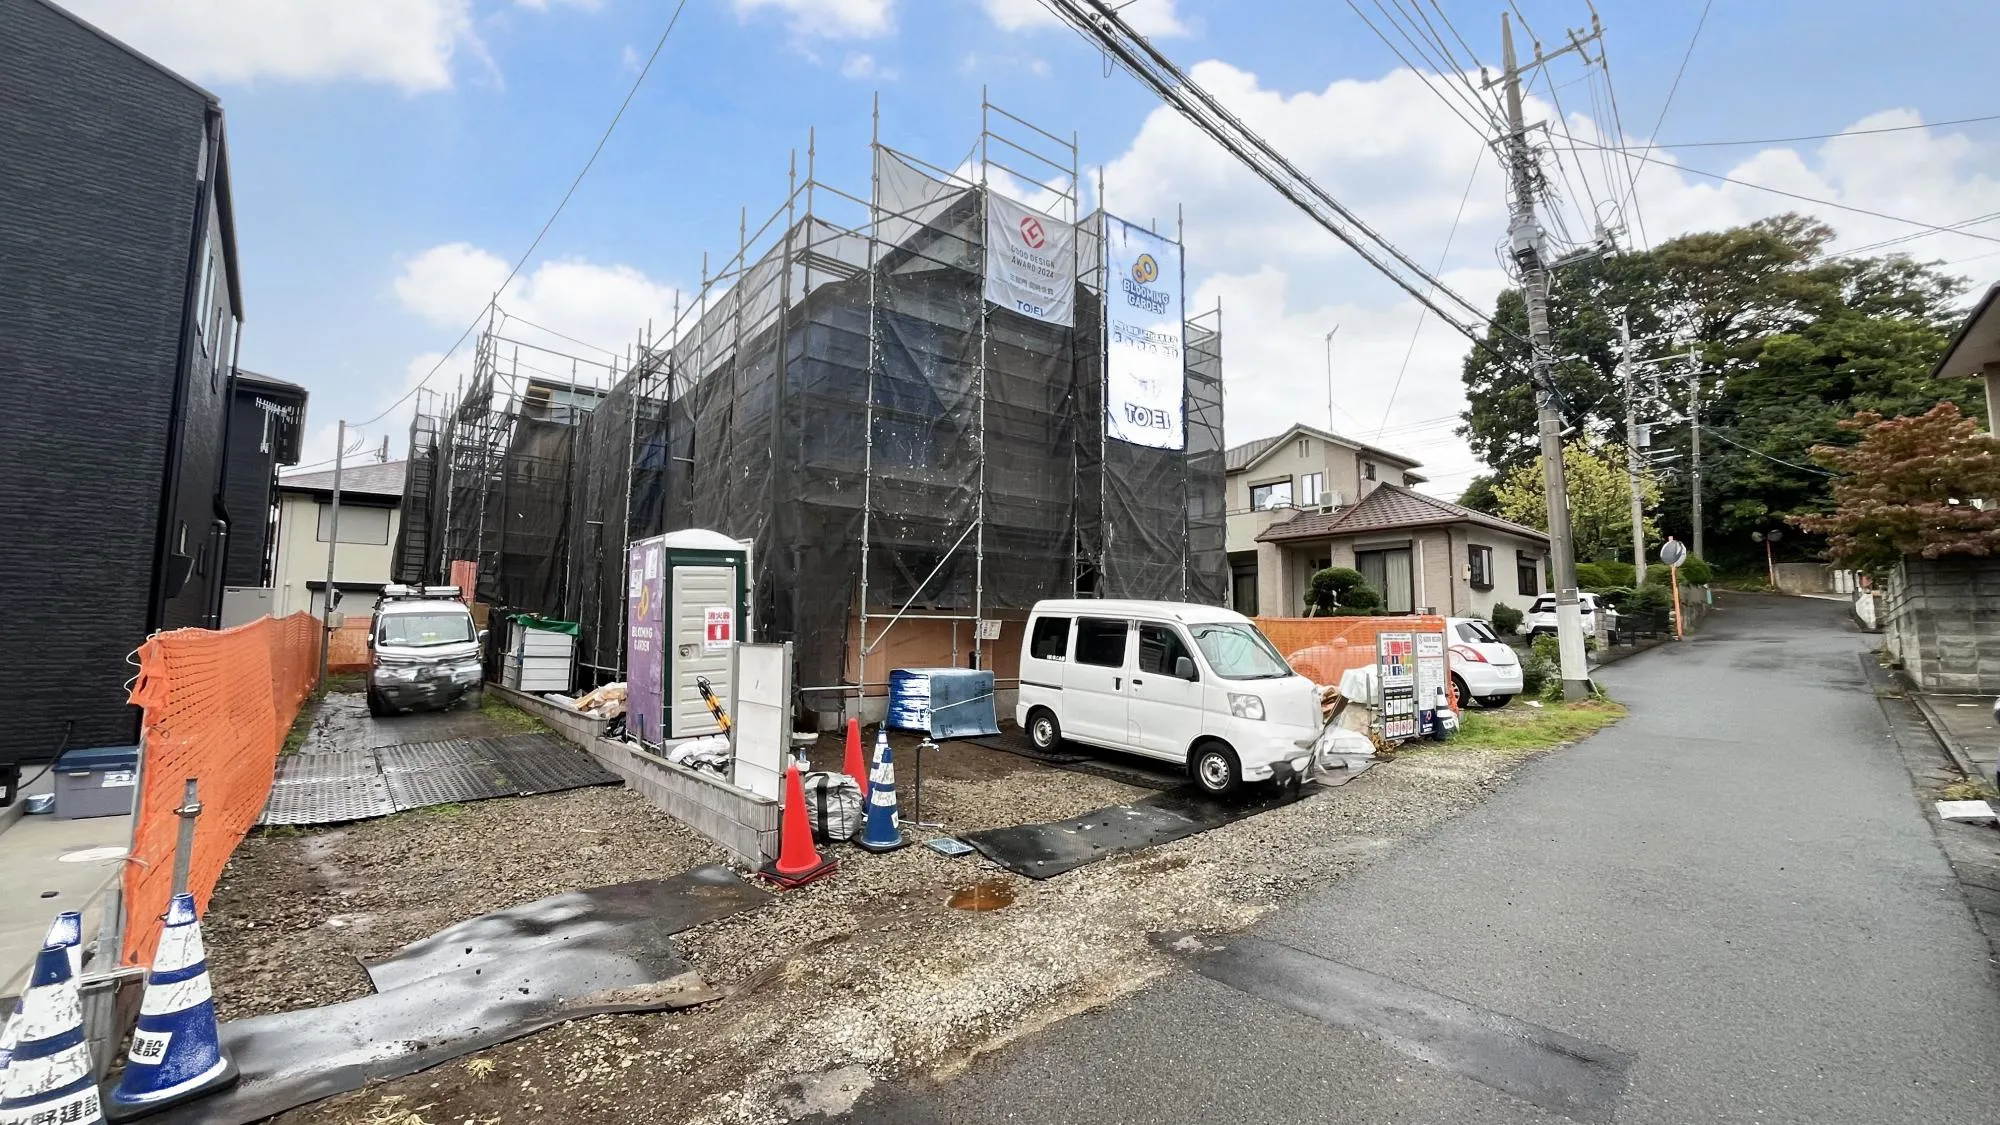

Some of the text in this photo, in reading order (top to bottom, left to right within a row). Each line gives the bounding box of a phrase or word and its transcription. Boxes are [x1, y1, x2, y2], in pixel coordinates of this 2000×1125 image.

[1010, 245, 1055, 269] GOOD DESIGN
[1011, 256, 1054, 279] AWARD 2024
[1122, 278, 1169, 304] BLOOMING
[1016, 299, 1044, 318] TOEI
[1128, 294, 1166, 315] GARDEN
[1124, 401, 1171, 429] TOEI
[131, 1036, 165, 1058] 建設
